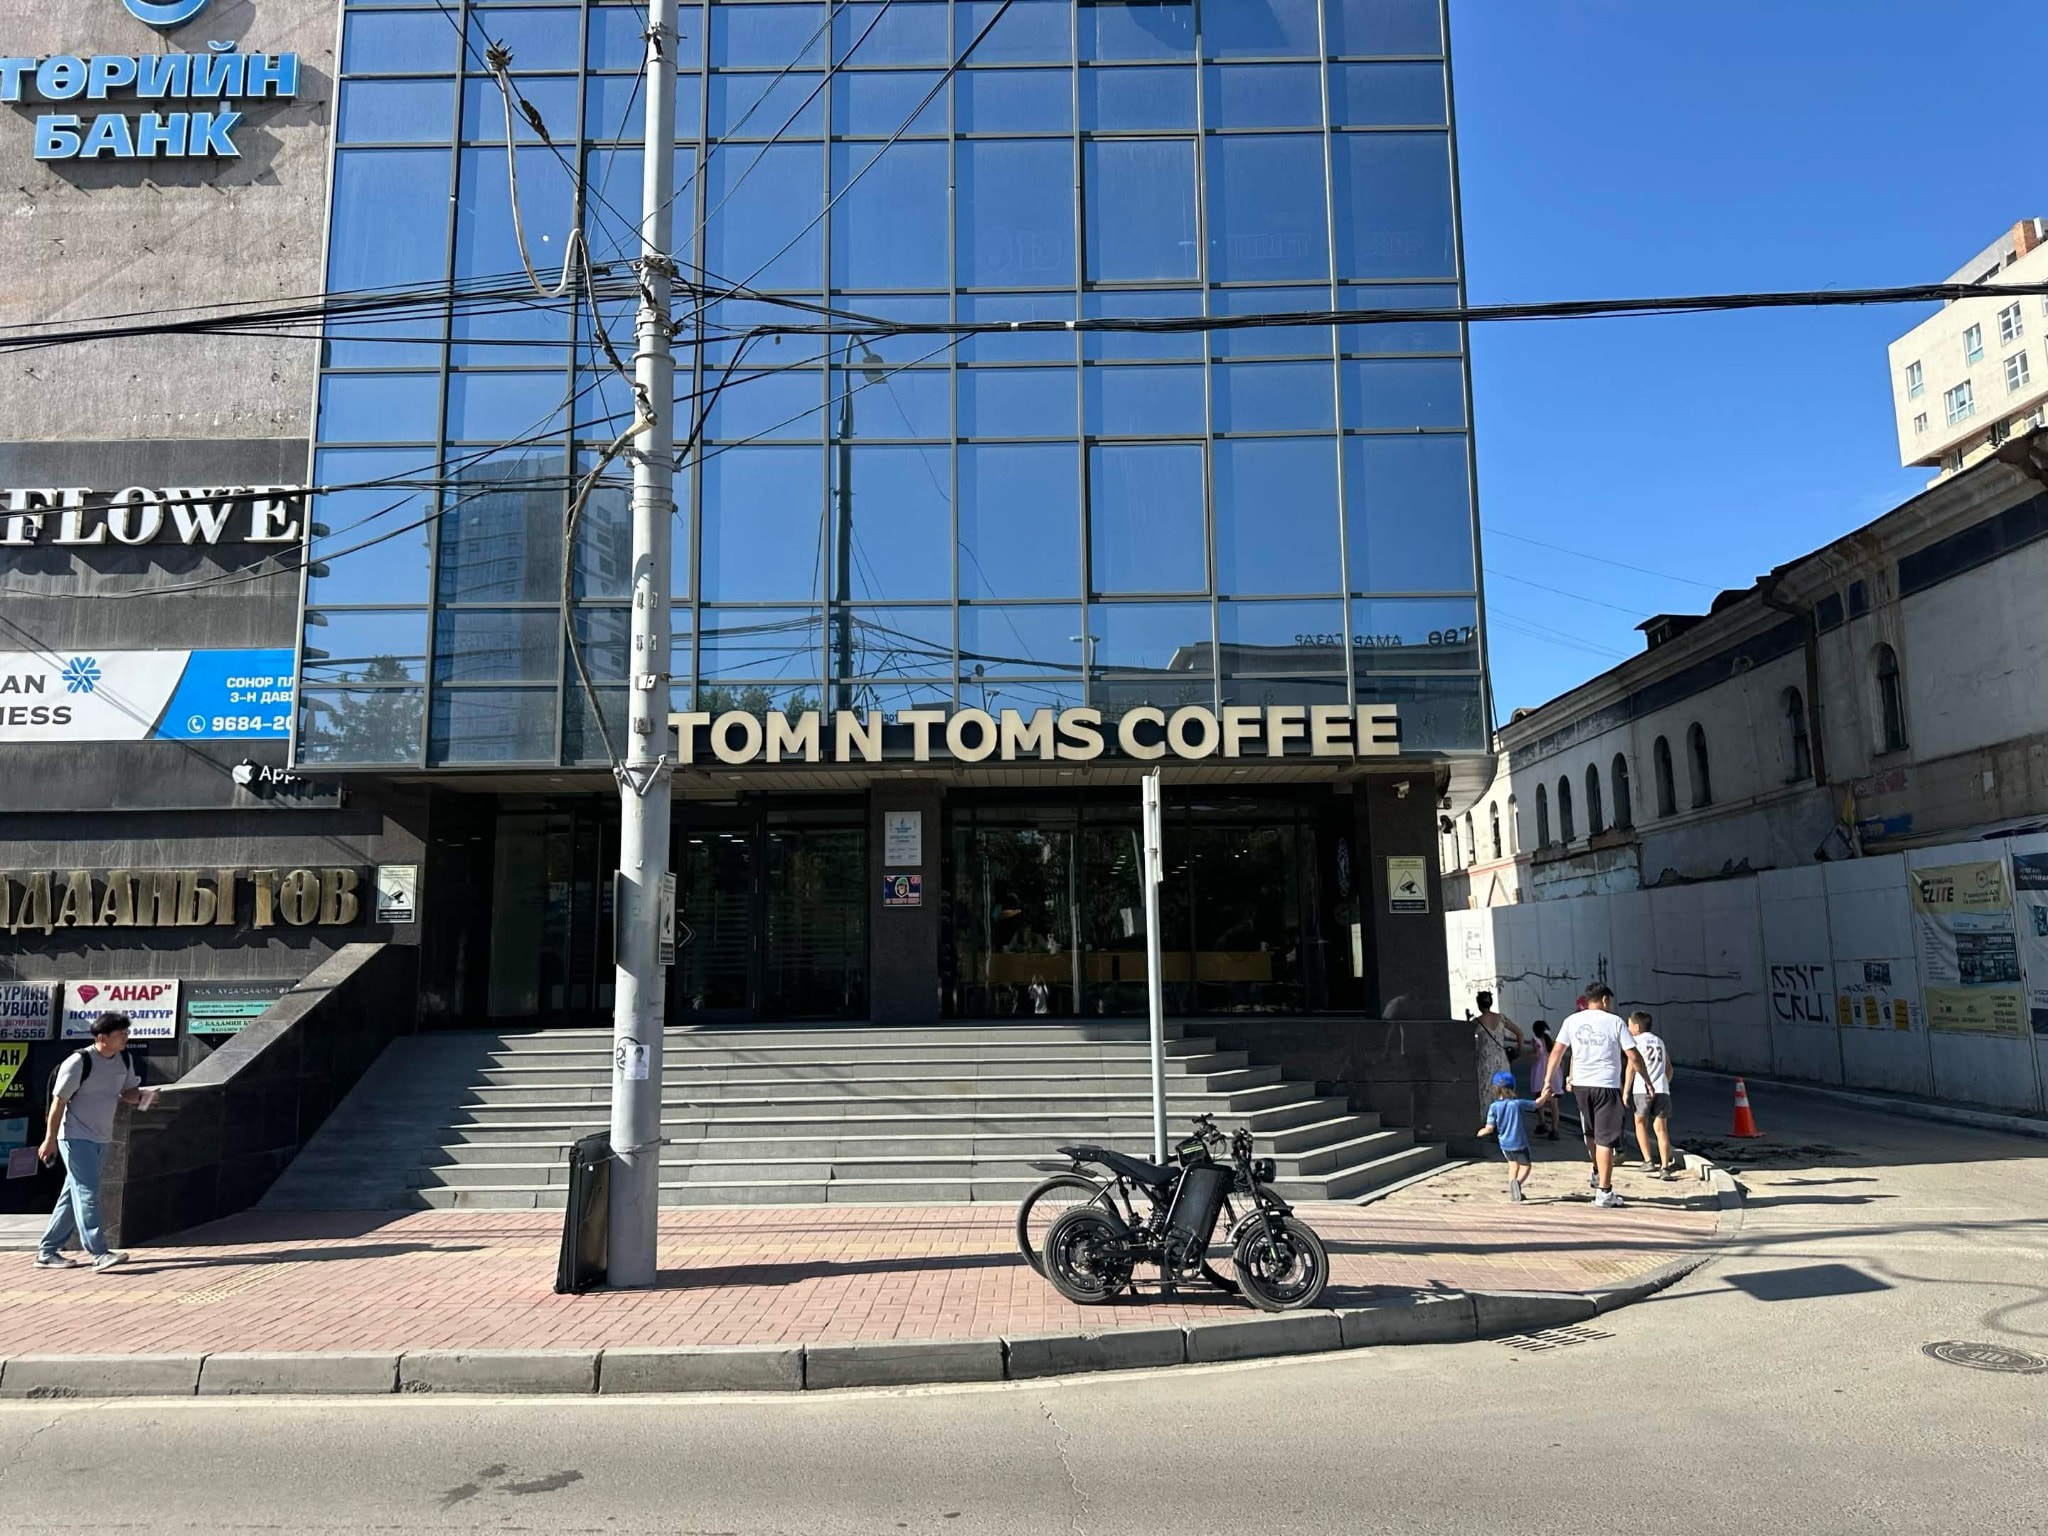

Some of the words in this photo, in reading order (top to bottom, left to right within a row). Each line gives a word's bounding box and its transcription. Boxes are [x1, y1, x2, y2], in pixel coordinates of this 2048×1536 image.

[0, 40, 299, 101] ТӨРИЙН
[34, 112, 243, 160] БАНК
[0, 486, 307, 545] FLOWE
[227, 677, 273, 688] СОНОР
[668, 710, 820, 764] TOM
[836, 710, 883, 762] N
[898, 706, 1105, 762] TOMS
[1118, 703, 1400, 760] COFFEE
[249, 868, 359, 930] ТӨВ
[104, 984, 171, 1001] "АНАР"
